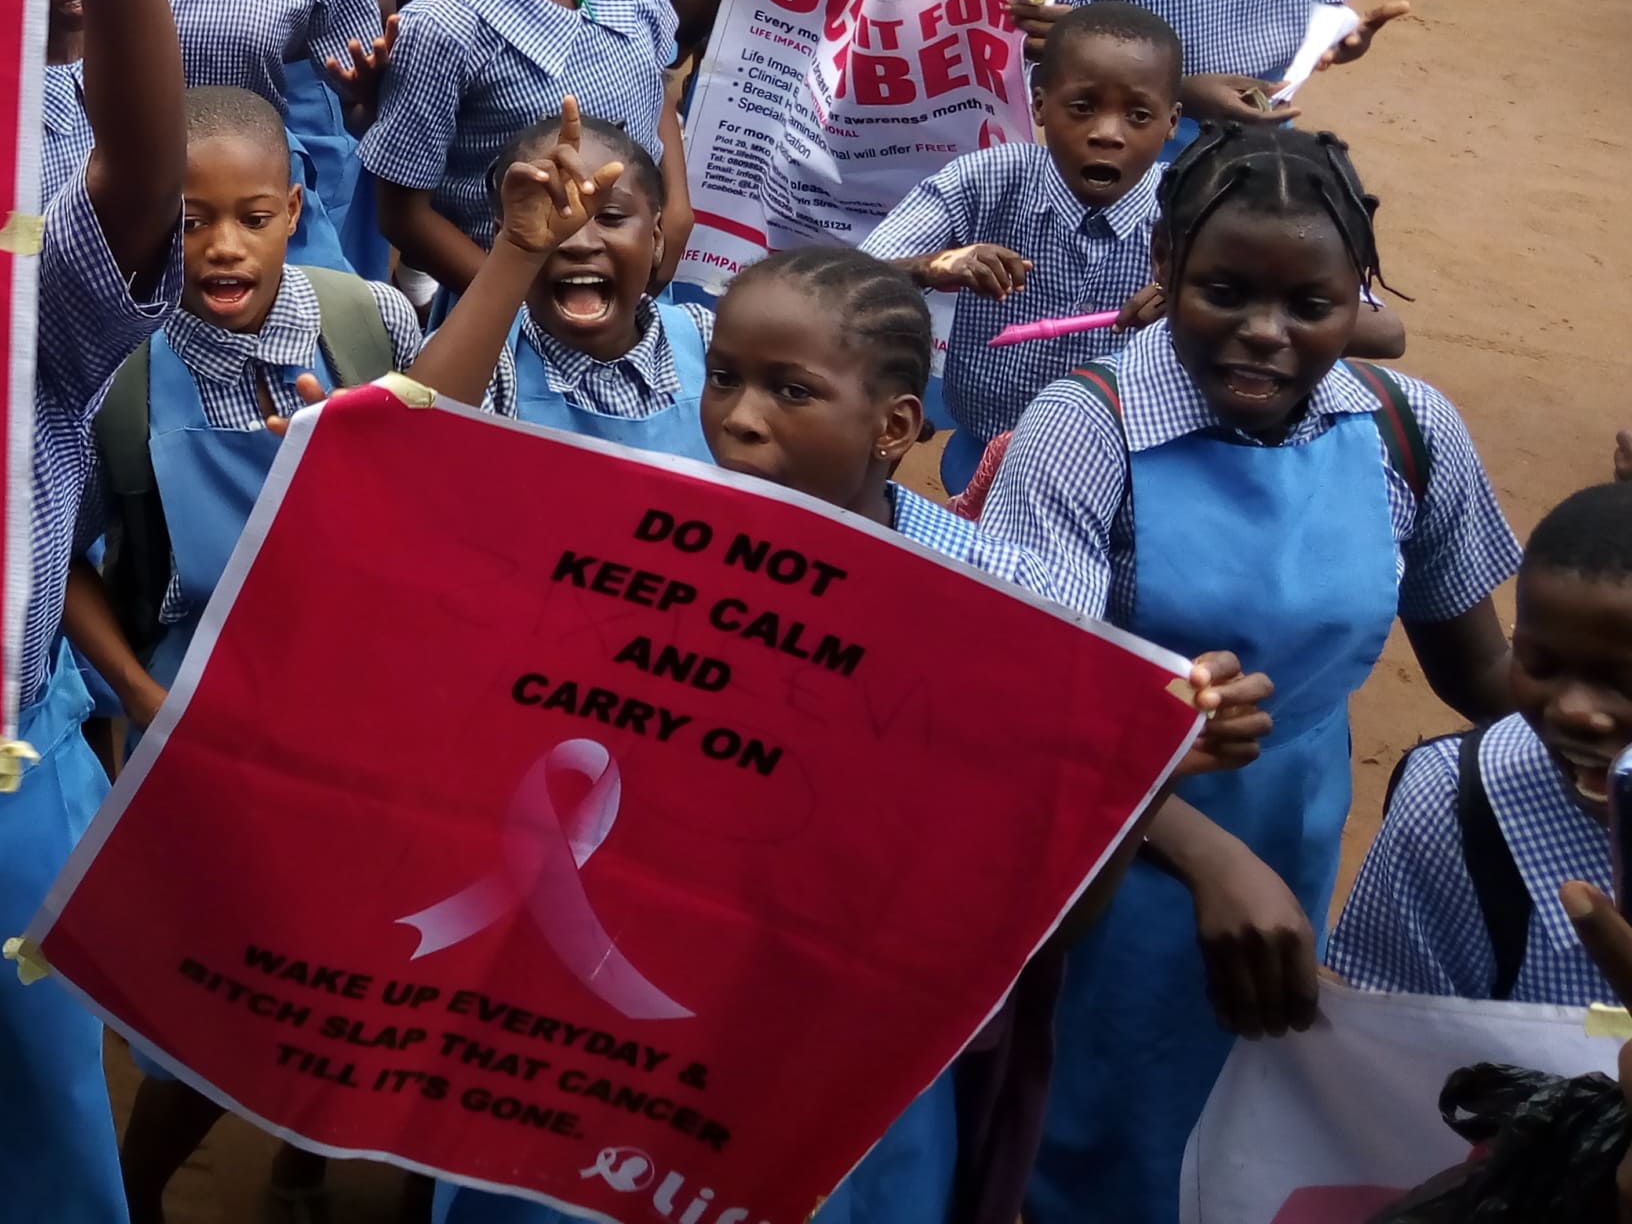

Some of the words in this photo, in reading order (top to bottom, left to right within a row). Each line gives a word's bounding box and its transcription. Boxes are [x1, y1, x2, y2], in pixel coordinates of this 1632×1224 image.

[748, 66, 793, 93] Clinical
[750, 26, 771, 41] LIFE
[773, 34, 813, 57] IMPACT
[754, 10, 795, 34] Every
[843, 113, 929, 125] awareness
[932, 97, 983, 119] month
[718, 119, 742, 134] For
[743, 127, 776, 146] more
[740, 47, 765, 64] Life
[853, 145, 876, 160] will
[880, 143, 911, 157] offer
[915, 143, 957, 153] FREE
[742, 81, 784, 106] Breast
[784, 130, 812, 158] cation
[680, 249, 700, 263] IFE
[633, 508, 714, 553] DO
[723, 533, 848, 597] NOT
[550, 550, 698, 613] KEEP
[708, 597, 866, 678] CALM
[613, 635, 732, 693] AND
[511, 673, 693, 743] CARRY
[700, 727, 784, 777] ON
[176, 956, 313, 1030] BITCH
[319, 1014, 429, 1053] SLAP
[438, 1029, 553, 1084] THAT
[556, 1068, 733, 1153] CANCER
[242, 943, 376, 1002] WAKE
[382, 979, 441, 1012] UP
[446, 988, 671, 1076] EVERYDAY
[677, 1061, 710, 1091] &
[274, 1041, 360, 1090] TILL
[459, 1086, 587, 1141] GONE.
